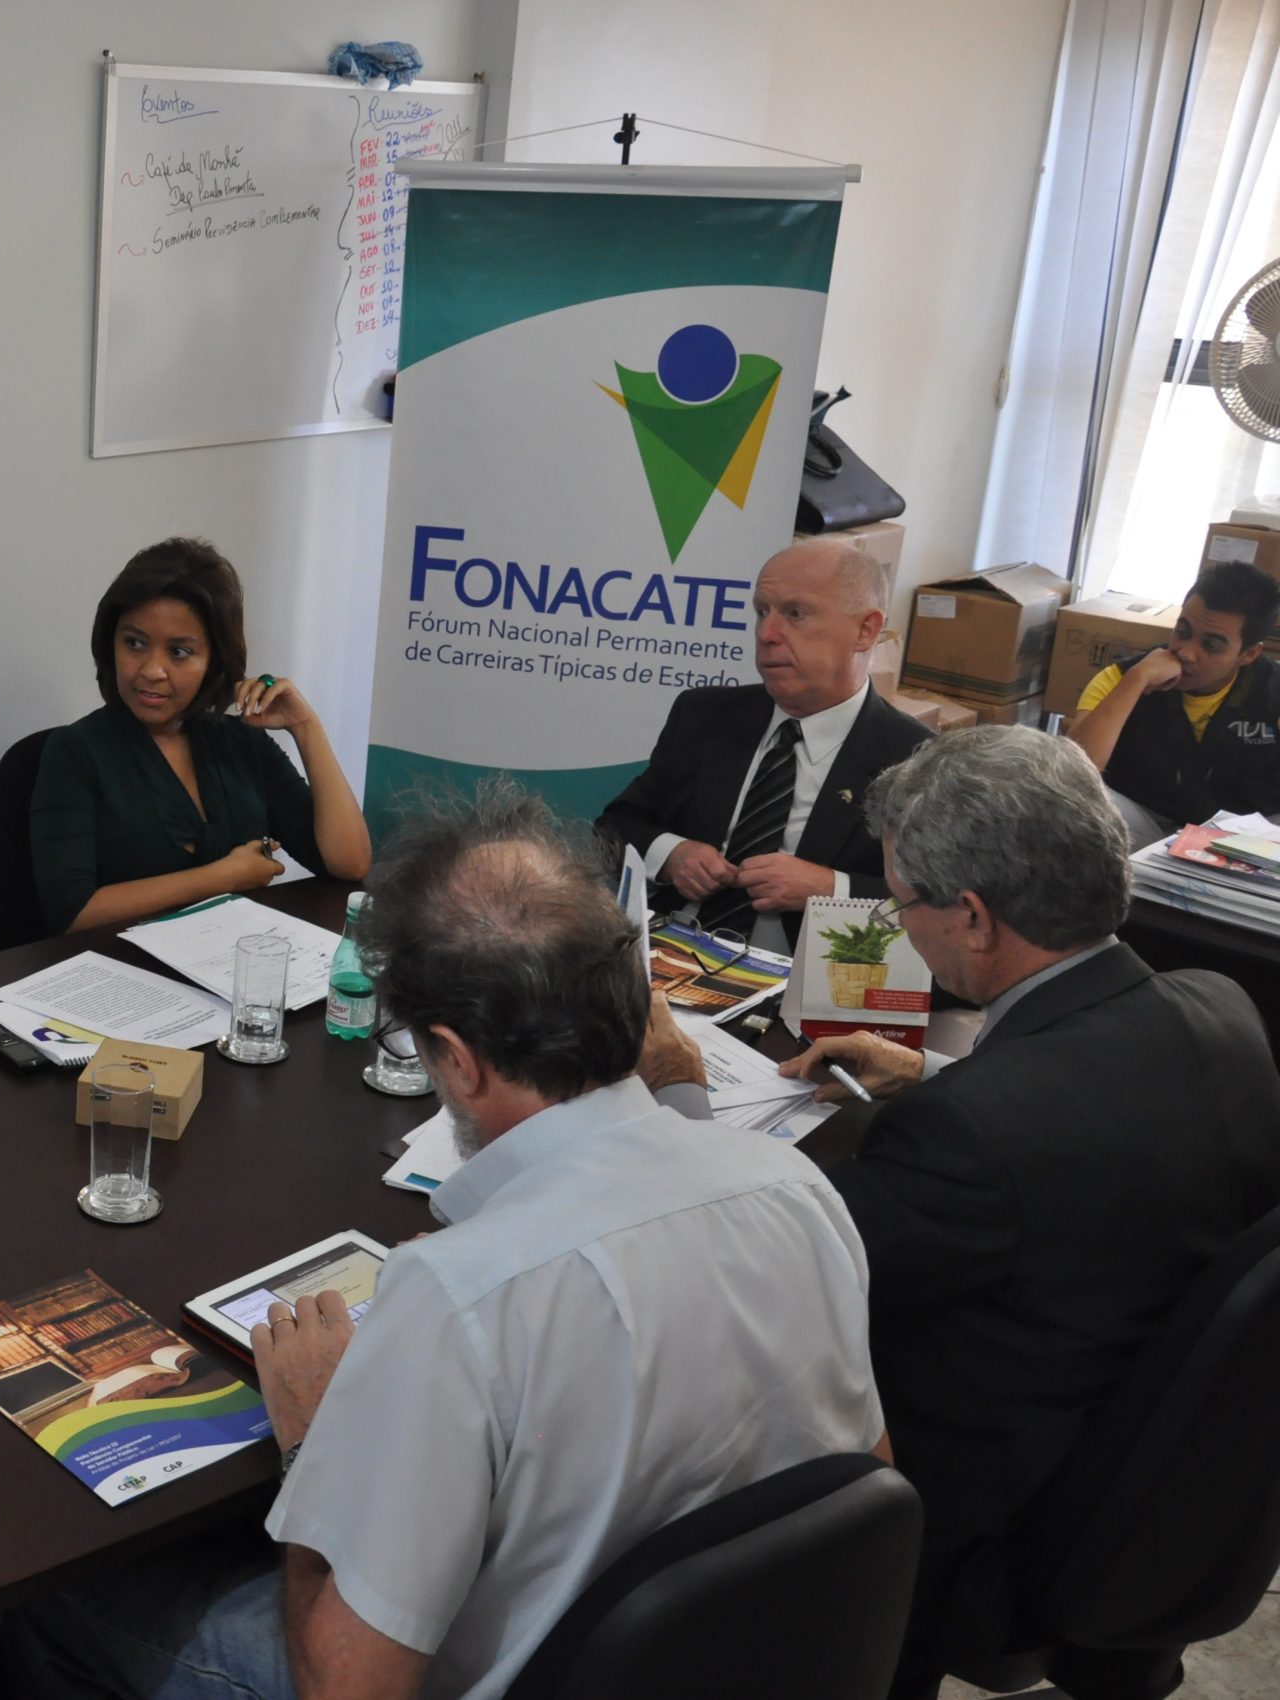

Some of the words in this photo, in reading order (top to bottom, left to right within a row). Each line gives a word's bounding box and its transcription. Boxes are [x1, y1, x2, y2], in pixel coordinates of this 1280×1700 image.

[145, 153, 172, 188] Café
[409, 525, 752, 630] FONACATE
[408, 611, 481, 638] Fórum
[488, 618, 589, 648] Nacional
[596, 629, 745, 662] Permanente
[405, 640, 432, 662] de
[437, 643, 535, 673] Carreiras
[540, 653, 617, 682] Típicas
[623, 661, 653, 684] de
[659, 666, 740, 689] Estado
[117, 1475, 148, 1491] CETAP
[162, 1461, 183, 1473] CAP
